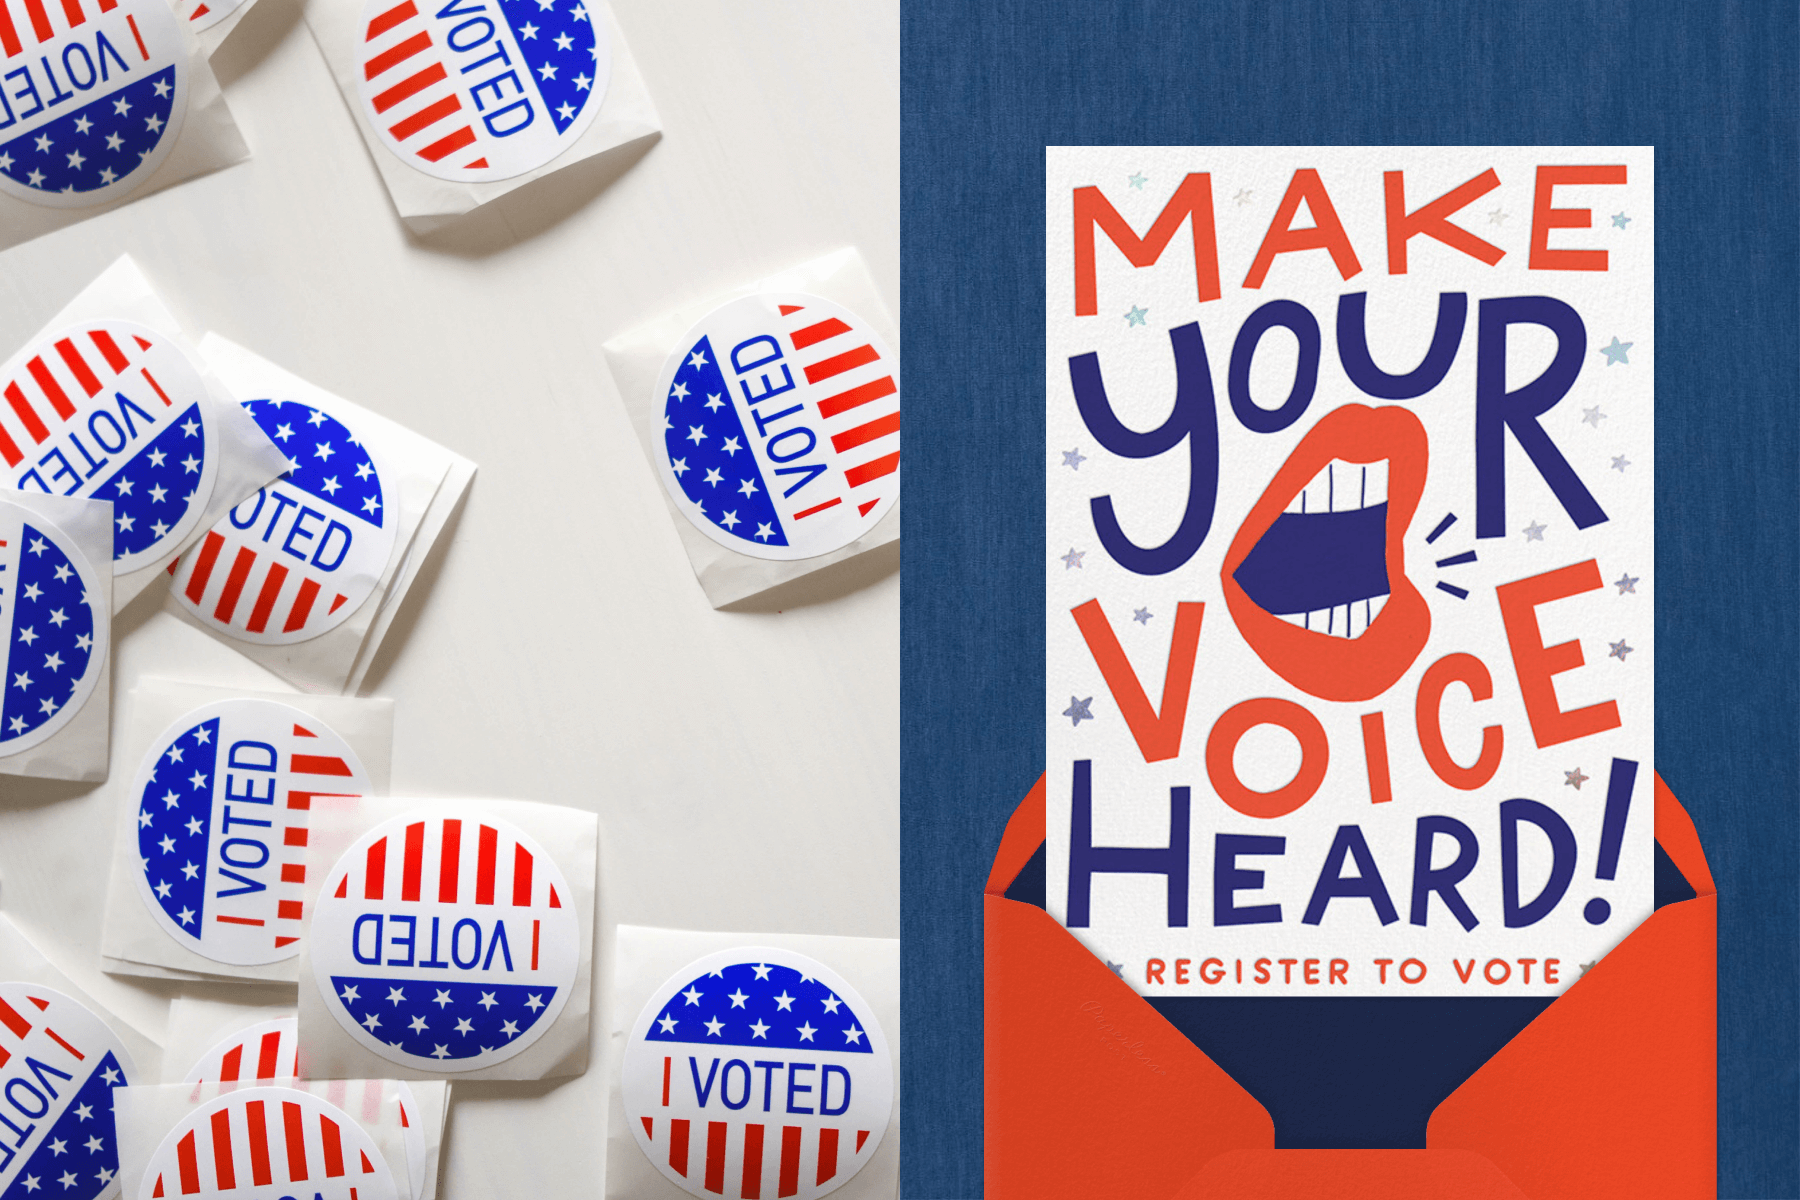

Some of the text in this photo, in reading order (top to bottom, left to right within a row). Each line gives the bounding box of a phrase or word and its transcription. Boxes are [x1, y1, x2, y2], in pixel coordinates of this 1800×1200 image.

[127, 14, 150, 62] I
[434, 0, 535, 138] VOTED
[1073, 164, 1628, 317] MAKE
[141, 367, 173, 407] I
[730, 334, 842, 521] I VOTED
[1068, 291, 1610, 576] YOUR
[229, 486, 353, 573] OTED
[1070, 558, 1622, 819] VOICE
[216, 739, 278, 927] I VOTED
[1066, 757, 1639, 933] HEARD!
[352, 913, 541, 972] I VOTED
[1145, 957, 1561, 985] REGISTER TO VOTE
[0, 1026, 86, 1174] I VOT
[662, 1056, 852, 1116] I VOTED
